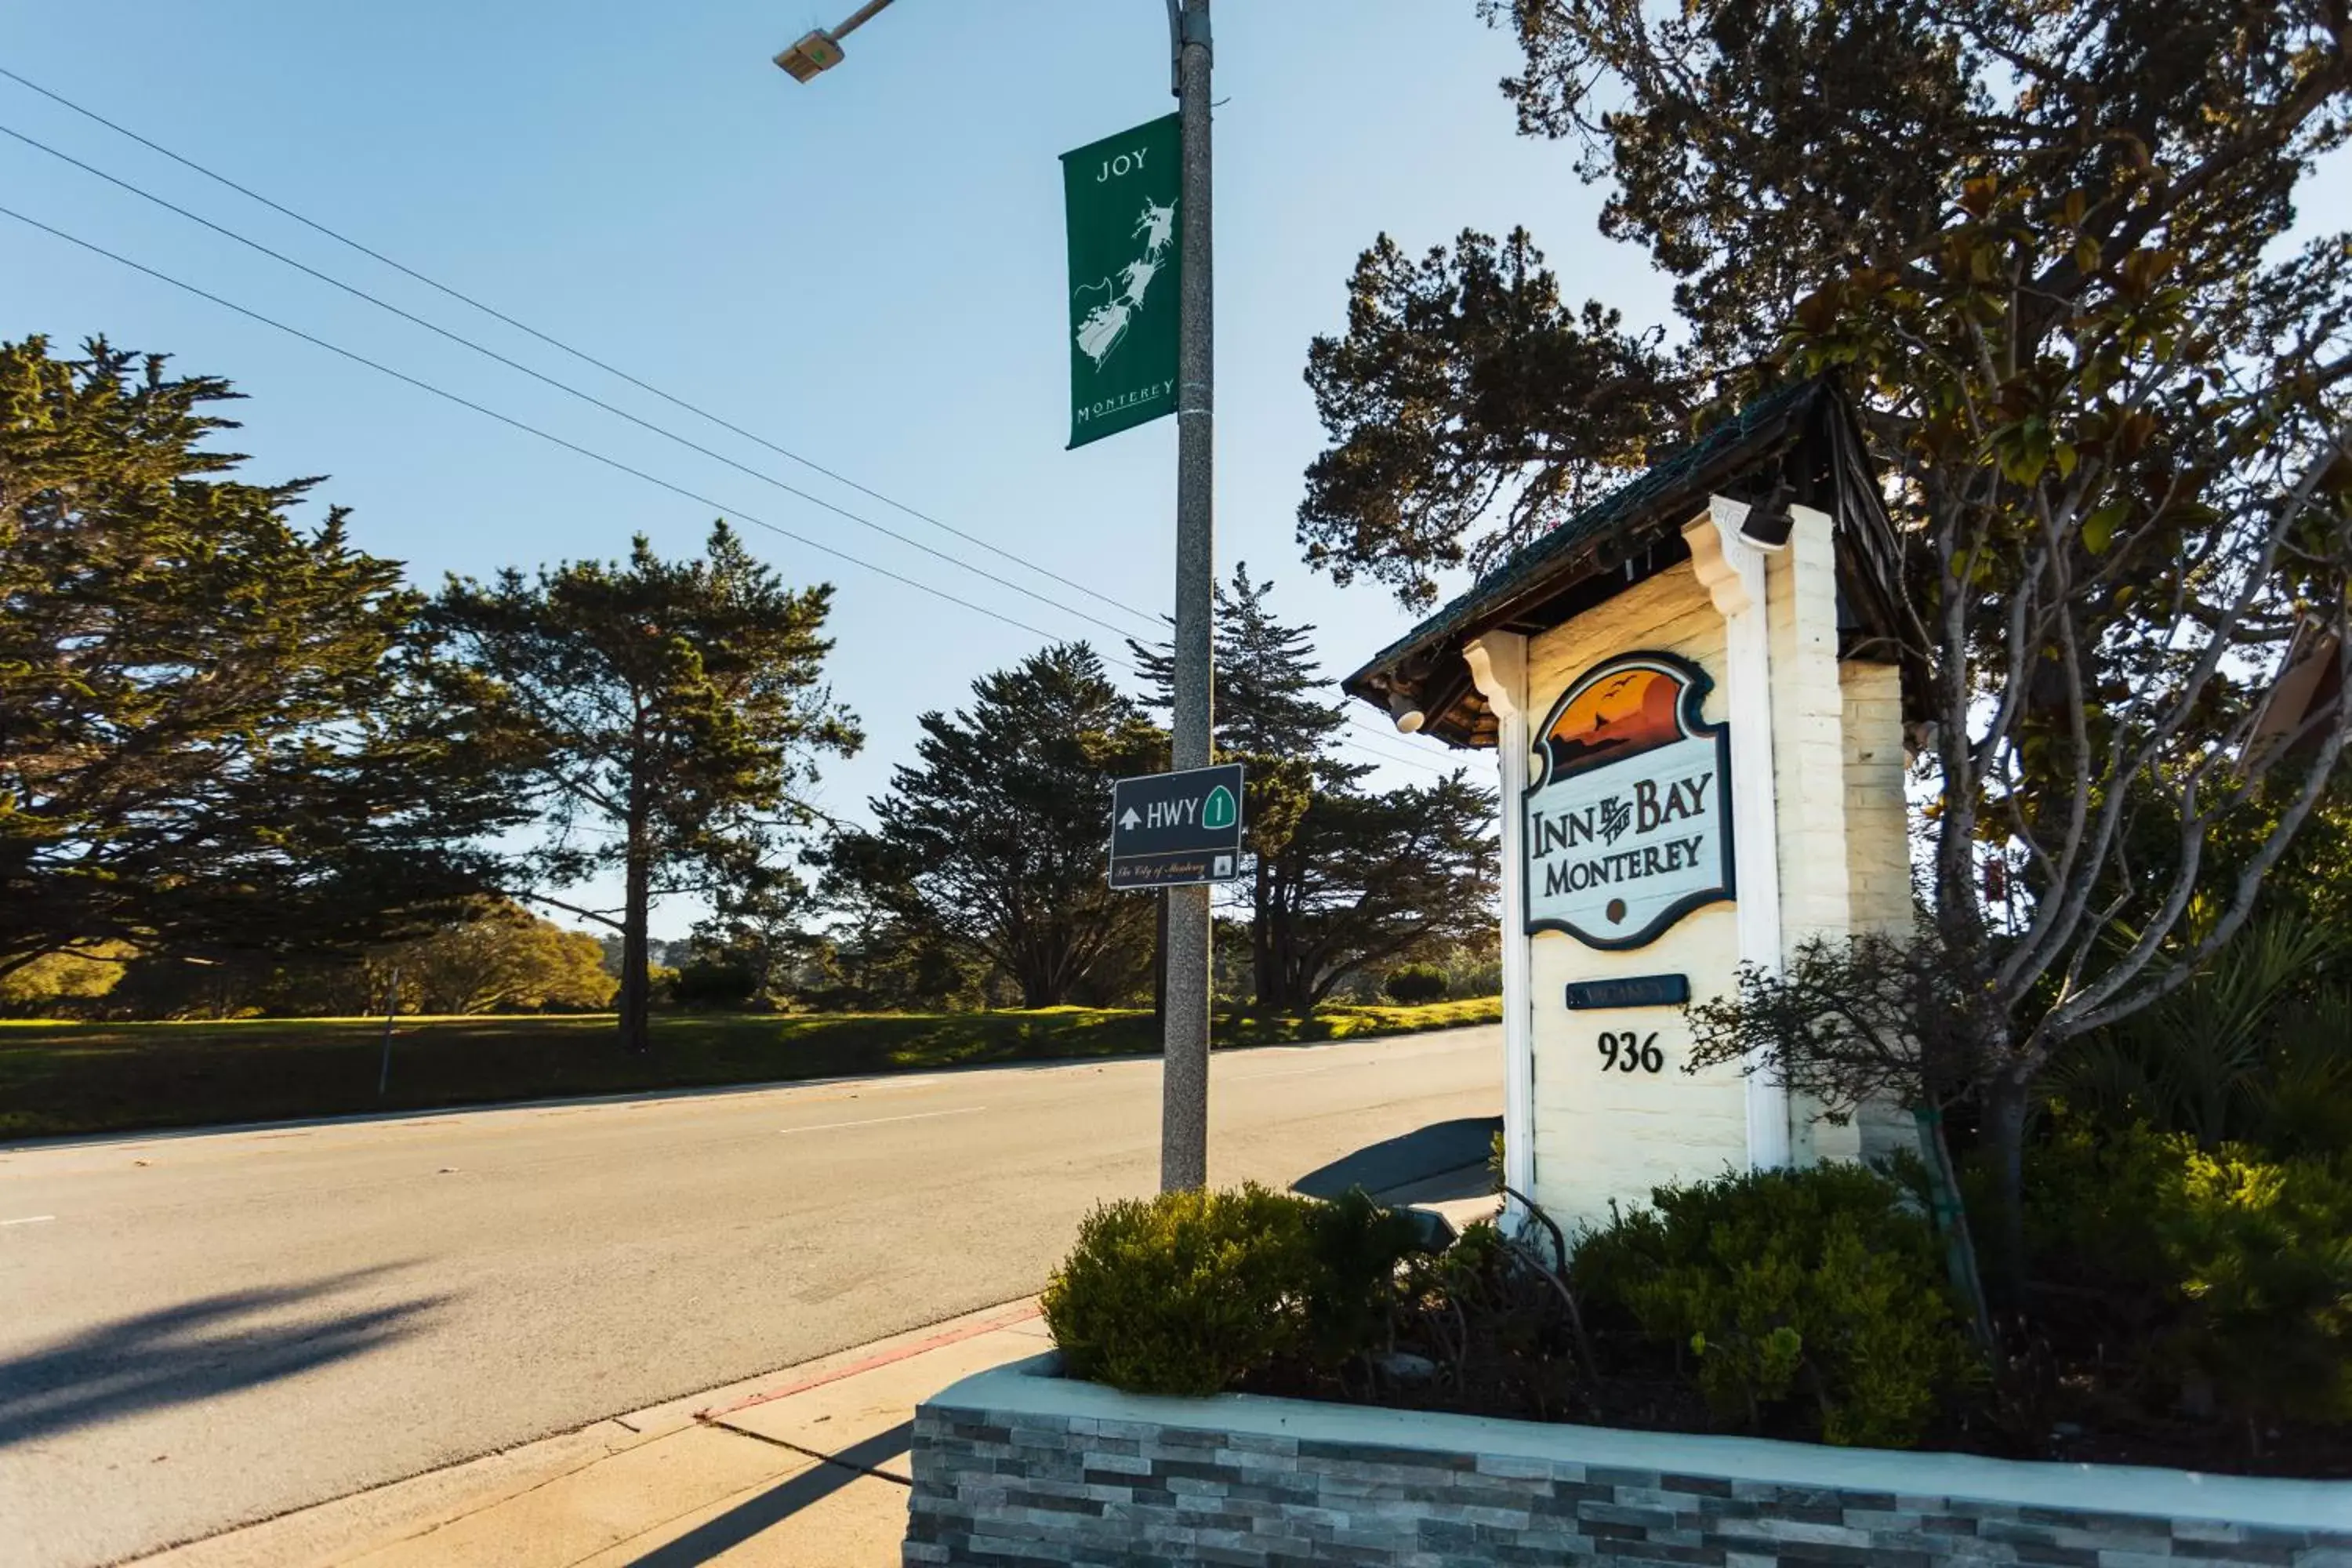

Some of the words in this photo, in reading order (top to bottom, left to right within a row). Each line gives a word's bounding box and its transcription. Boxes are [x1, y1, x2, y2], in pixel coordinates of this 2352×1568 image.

[1096, 147, 1149, 183] JOY
[1077, 379, 1174, 424] MONTEREY
[1147, 797, 1199, 829] HWY
[1216, 796, 1223, 822] 1
[1600, 796, 1620, 824] BY
[1633, 772, 1713, 835] BAY
[1531, 808, 1595, 859] INN
[1605, 808, 1632, 847] THE
[1544, 835, 1703, 897] MONTEREY
[1598, 1032, 1664, 1073] 936
